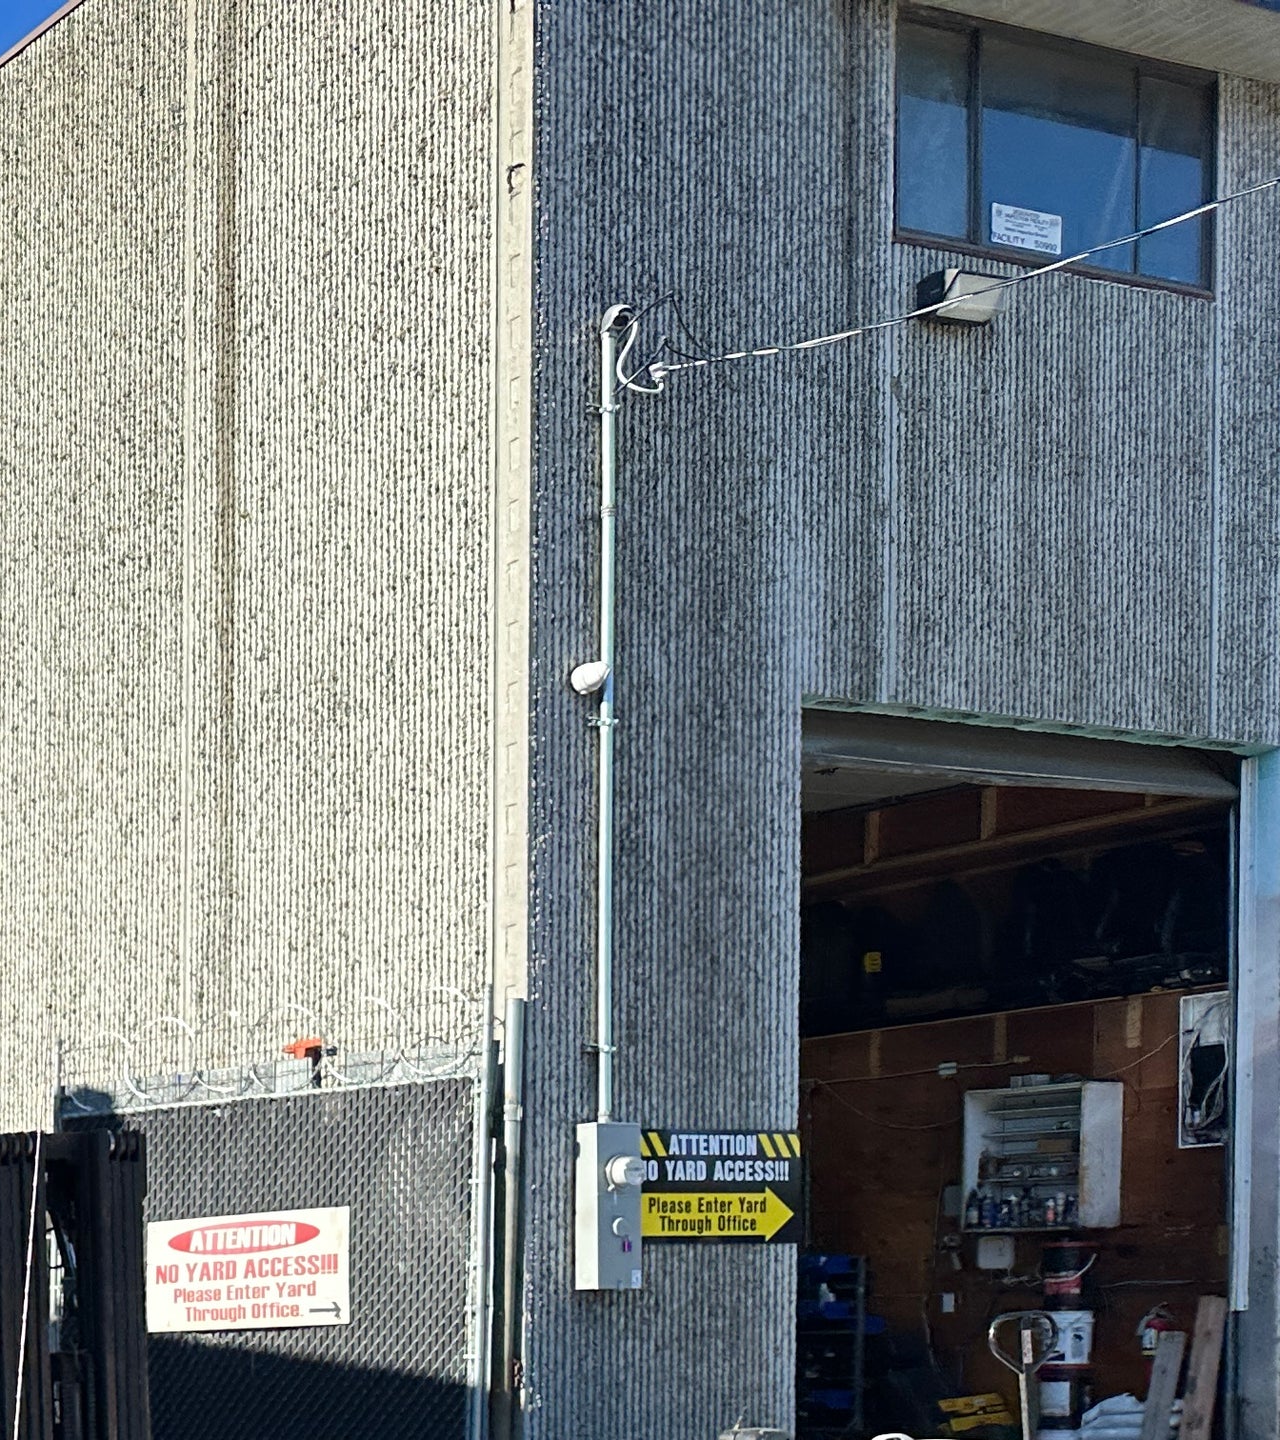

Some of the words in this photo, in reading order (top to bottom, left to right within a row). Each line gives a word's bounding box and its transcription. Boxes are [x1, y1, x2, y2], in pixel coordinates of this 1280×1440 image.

[992, 231, 1026, 245] FACILITY
[669, 1134, 758, 1155] ATTENTION
[666, 1161, 707, 1181] YARD
[713, 1161, 790, 1182] ACCESS!!!
[648, 1197, 691, 1214] Please
[697, 1198, 732, 1213] Enter
[739, 1197, 767, 1213] Yard
[659, 1215, 712, 1234] Through
[718, 1216, 757, 1231] Office
[190, 1223, 297, 1252] ATTENTION
[155, 1264, 179, 1284] NO
[187, 1260, 237, 1282] YARD
[243, 1254, 339, 1279] ACCESS!!!
[173, 1285, 221, 1303] Please
[227, 1284, 270, 1300] Enter
[276, 1281, 317, 1298] Yard
[185, 1304, 246, 1322] Through
